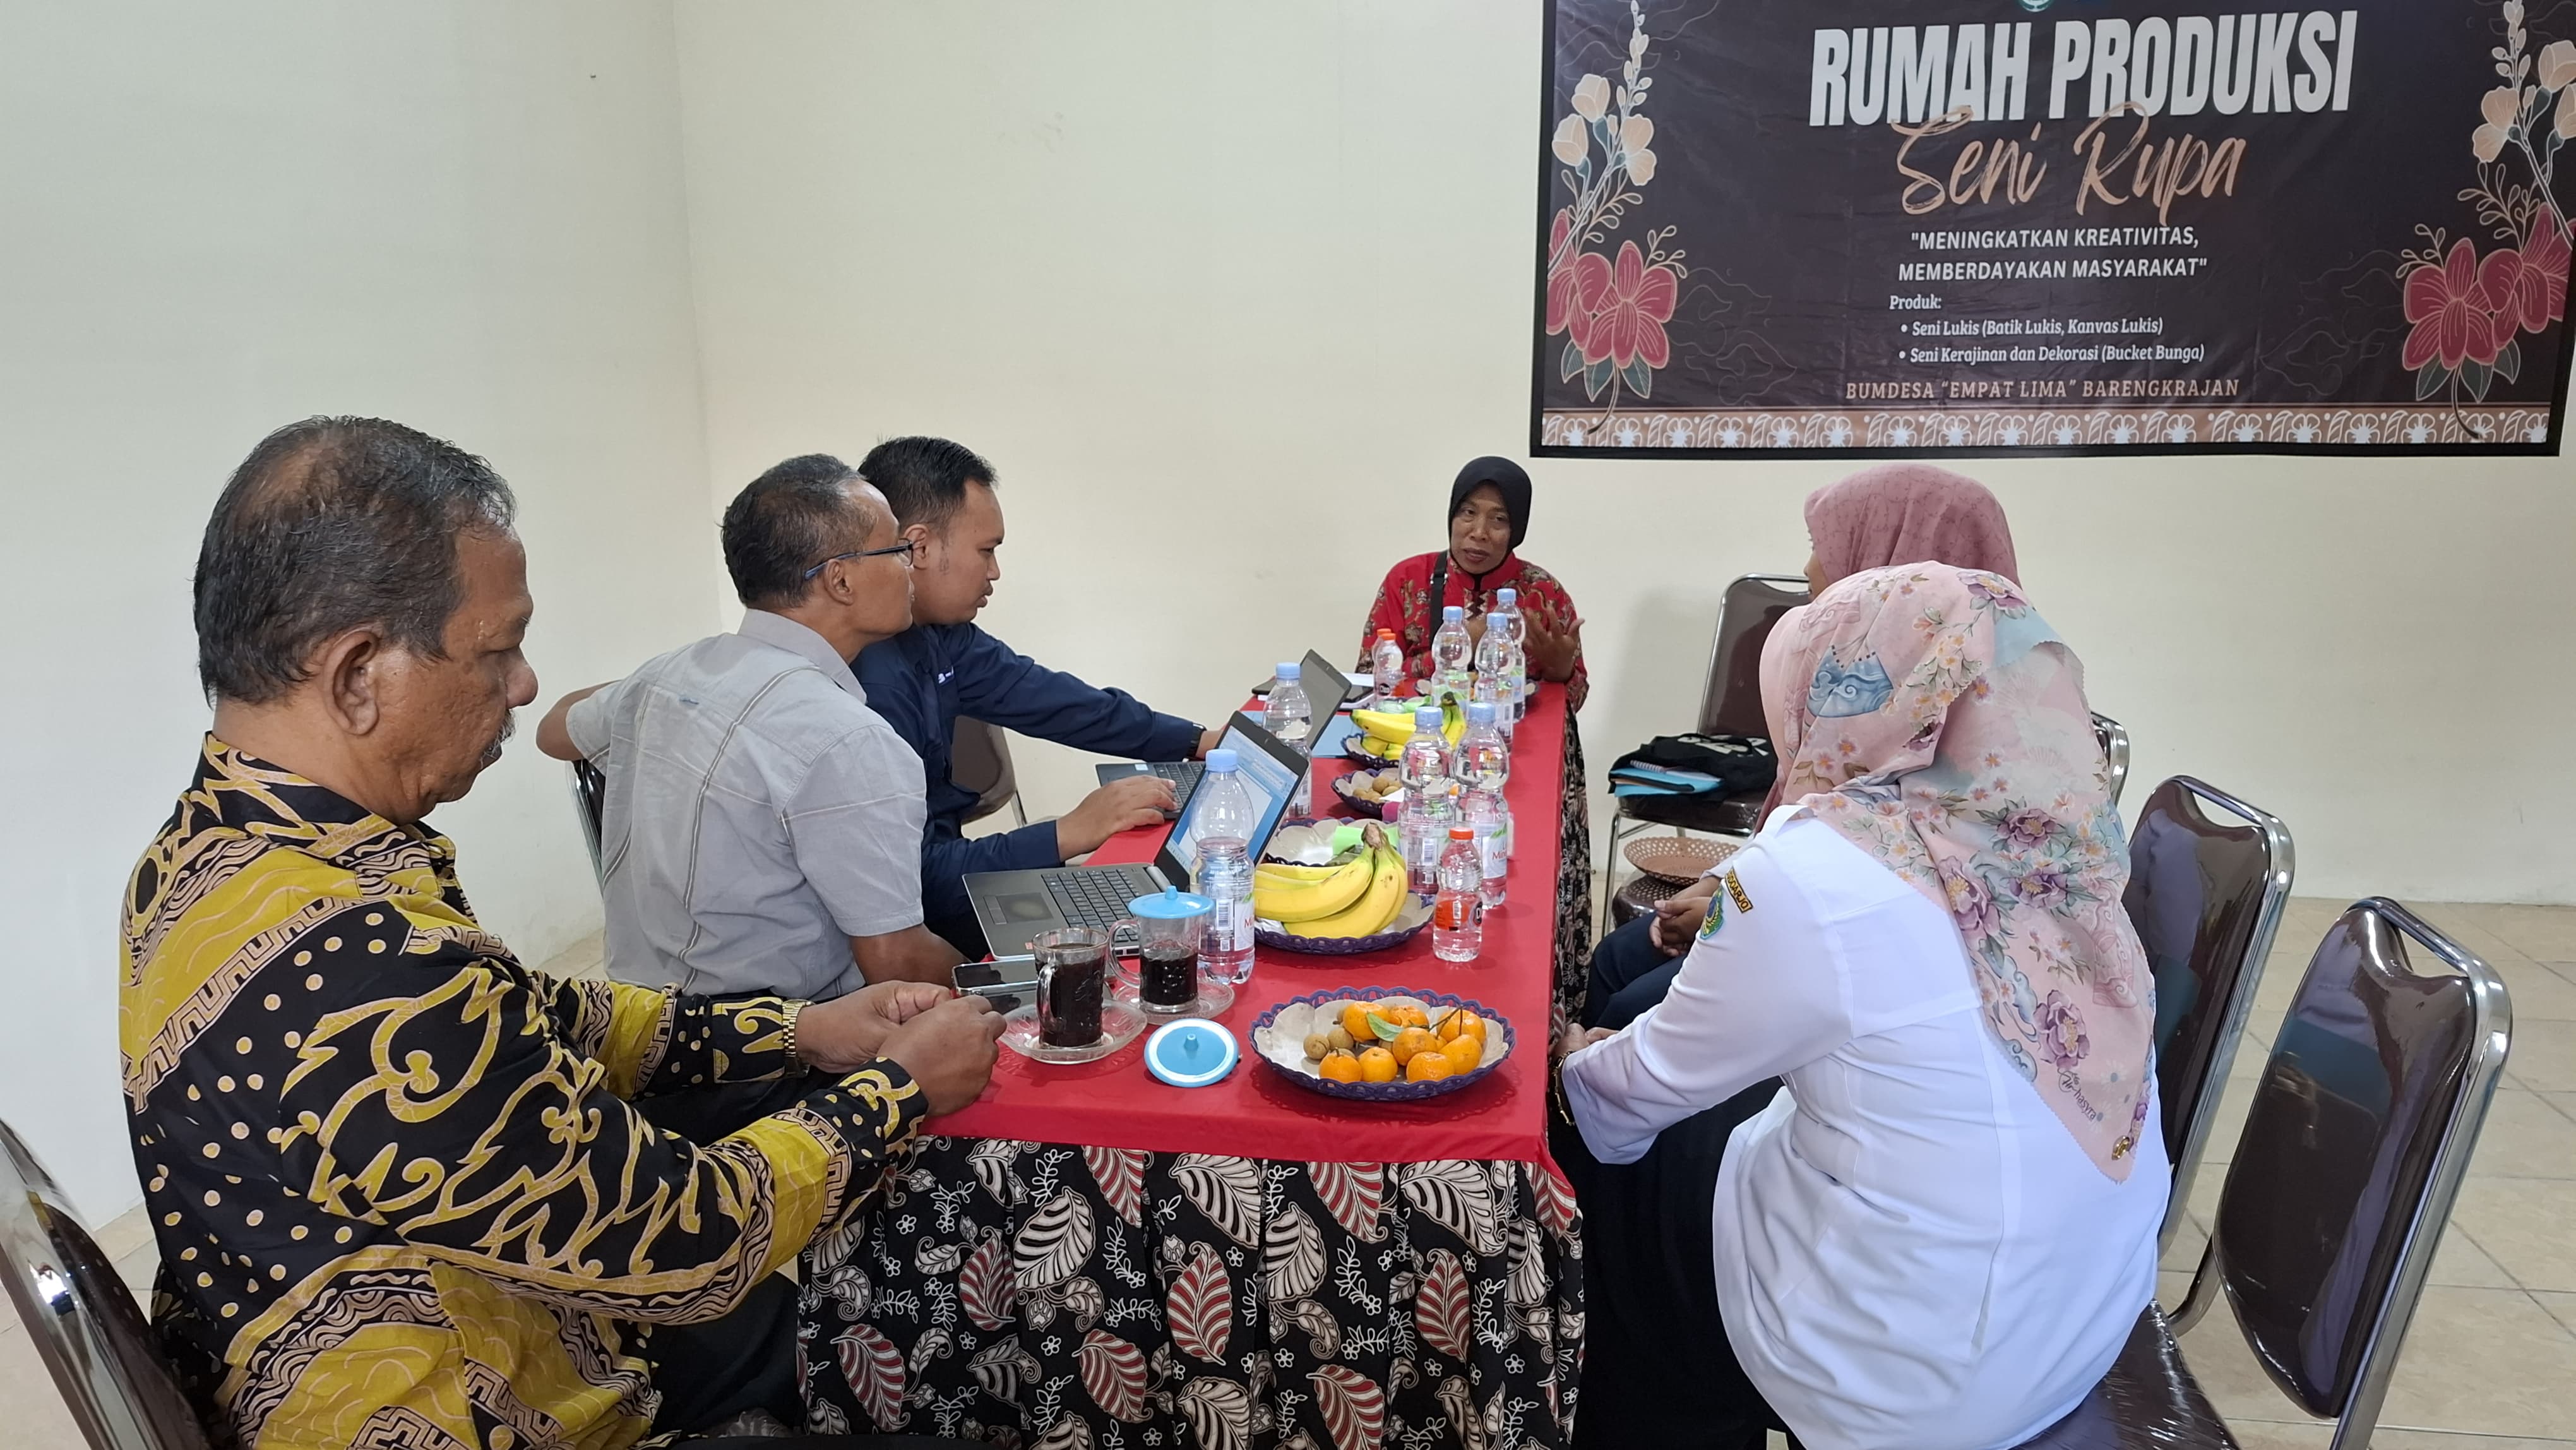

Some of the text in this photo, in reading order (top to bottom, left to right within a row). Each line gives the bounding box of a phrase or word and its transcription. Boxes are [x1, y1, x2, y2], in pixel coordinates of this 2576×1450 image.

[1810, 10, 2358, 126] RUMAH PRODUKSI
[1891, 101, 2246, 226] Seni Rupa
[1911, 227, 2198, 249] "MENINGKATKAN KREATIVITAS,
[1899, 258, 2207, 281] MEMBERDAYAKAN MASYARAKAT"
[1889, 294, 1942, 309] Produk:
[1912, 317, 2164, 337] Seni Lukis (Batik Lukis, Kanvas Lukis)
[1910, 344, 2205, 366] Seni Kerajinan dan Dekorasi (Bucket Bunga)
[1846, 378, 2239, 400] BUMDESA “EMPAT LIMA” BARENGKRAJAN
